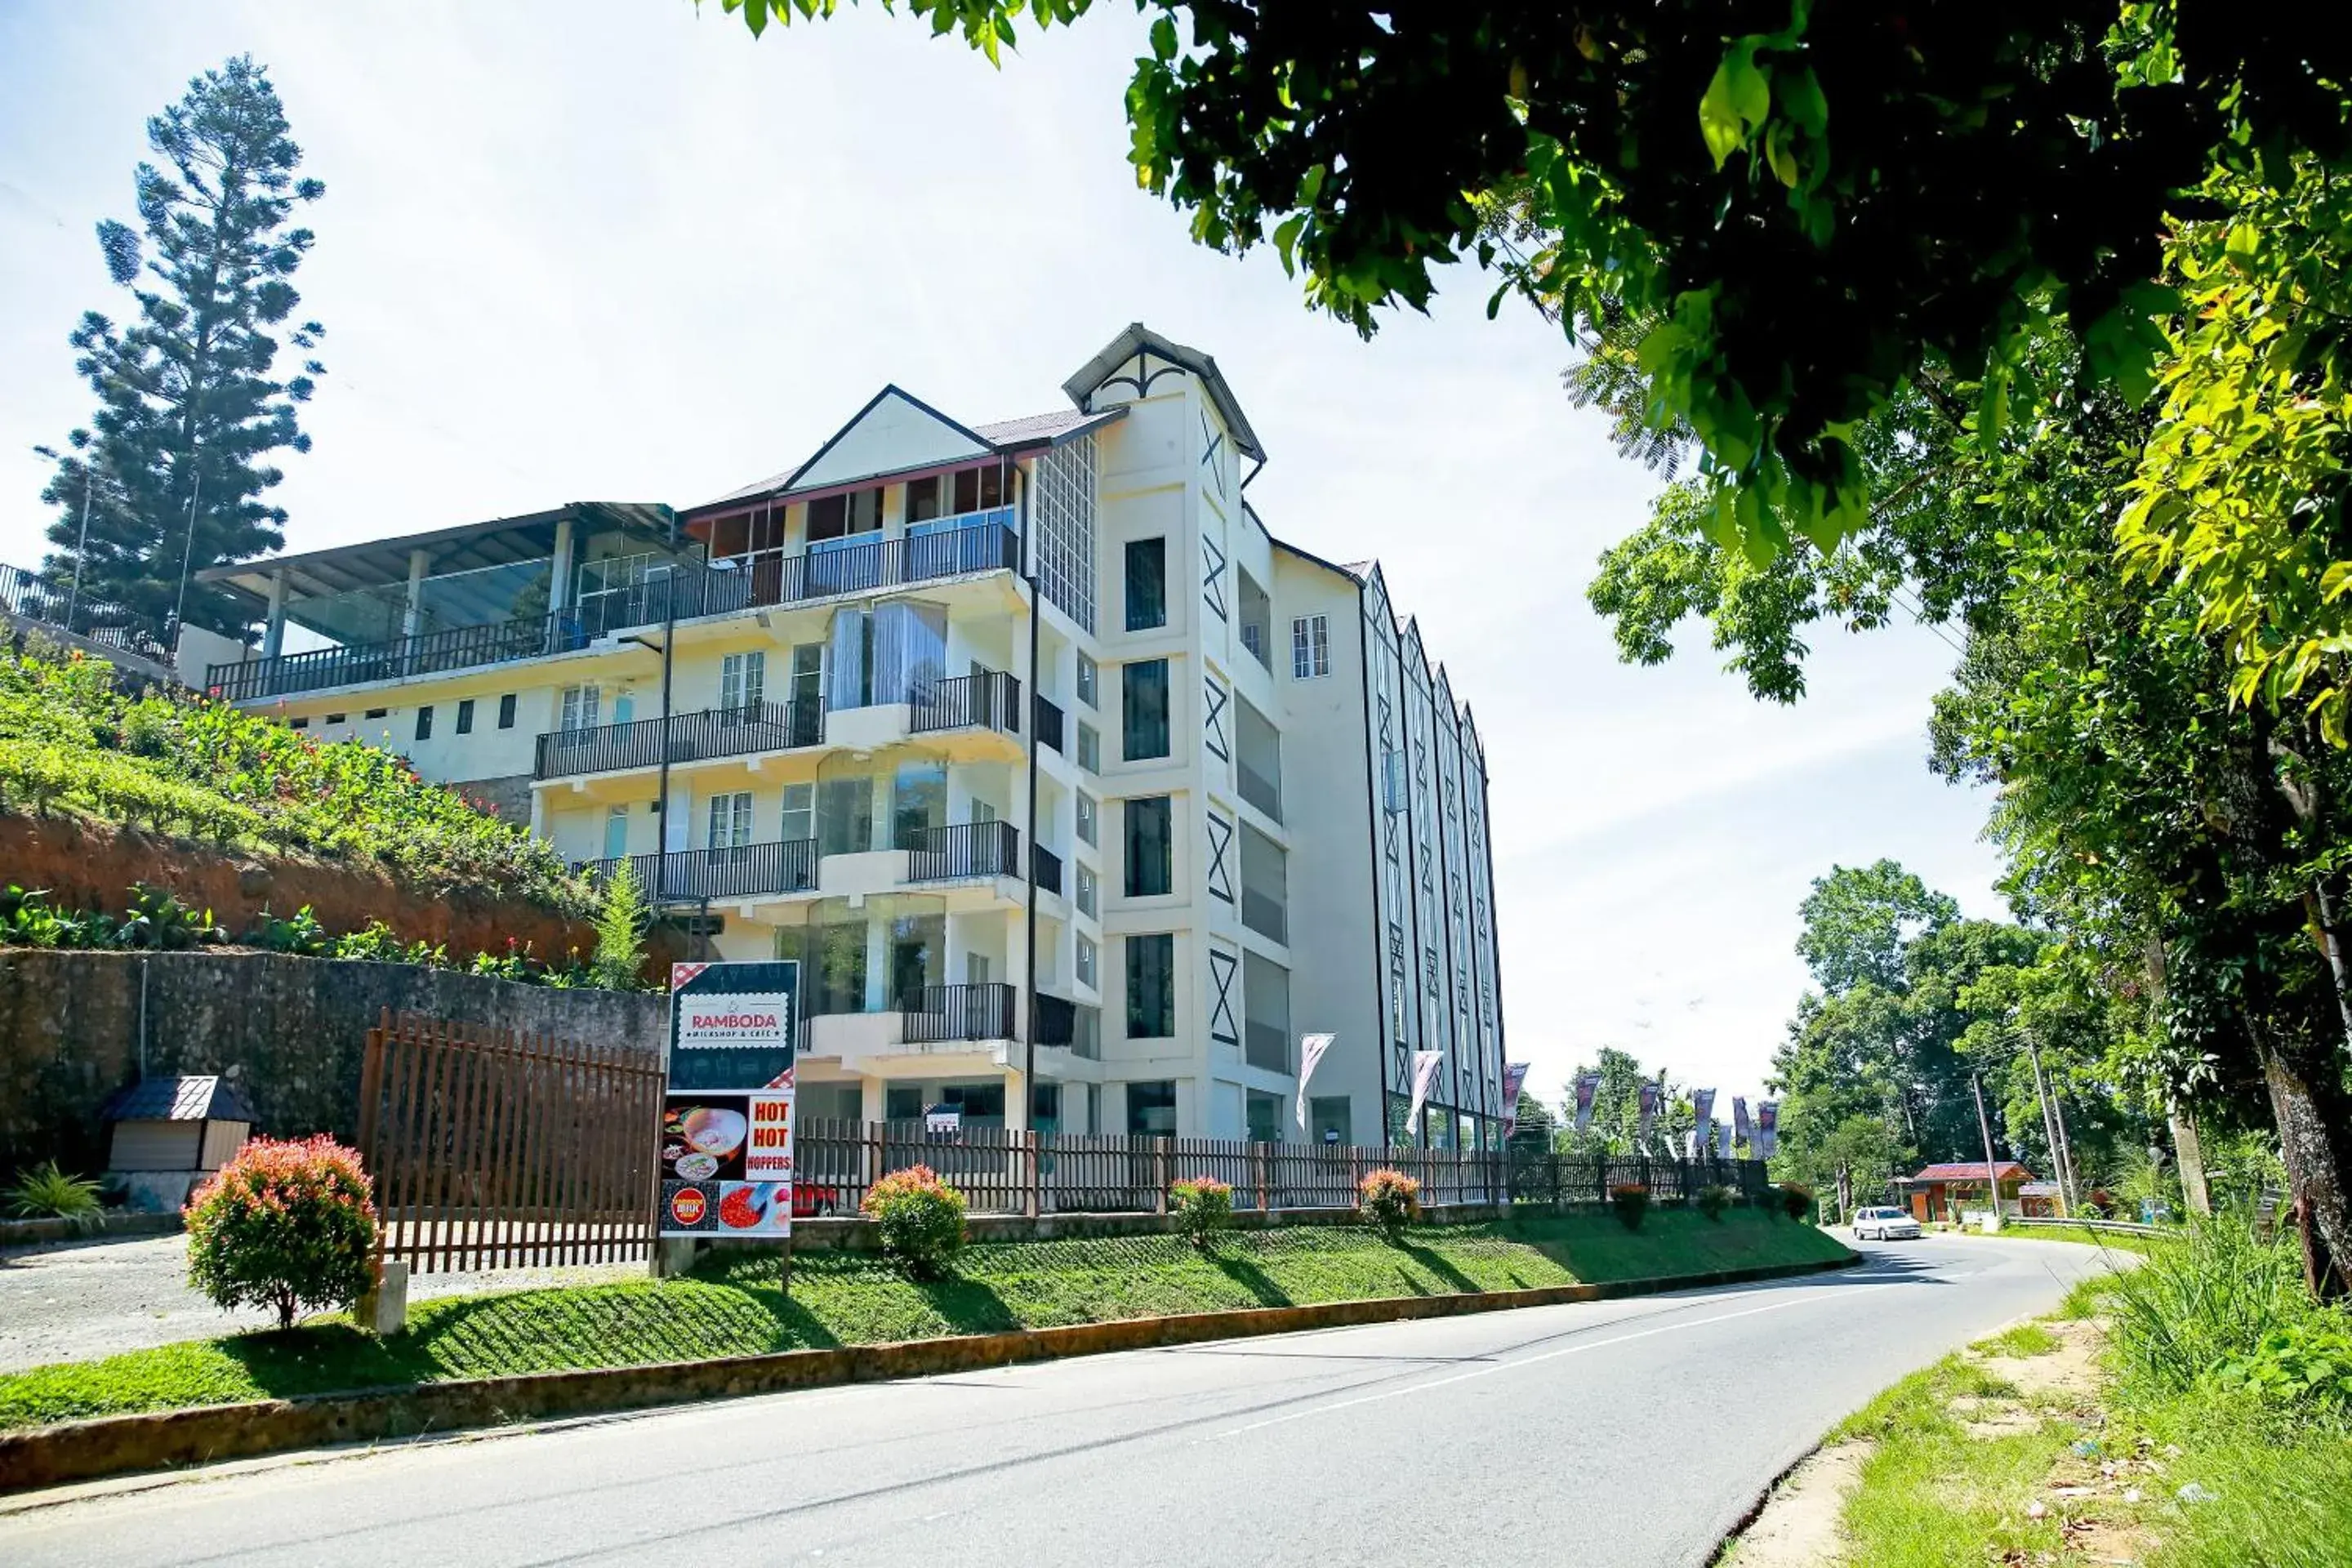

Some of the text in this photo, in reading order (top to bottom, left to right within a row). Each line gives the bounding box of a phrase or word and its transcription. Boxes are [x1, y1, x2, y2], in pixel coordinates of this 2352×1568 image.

[693, 1014, 777, 1028] RAMBODA
[755, 1102, 789, 1121] HOT
[754, 1129, 788, 1147] HOT
[748, 1156, 790, 1170] HOPPERS
